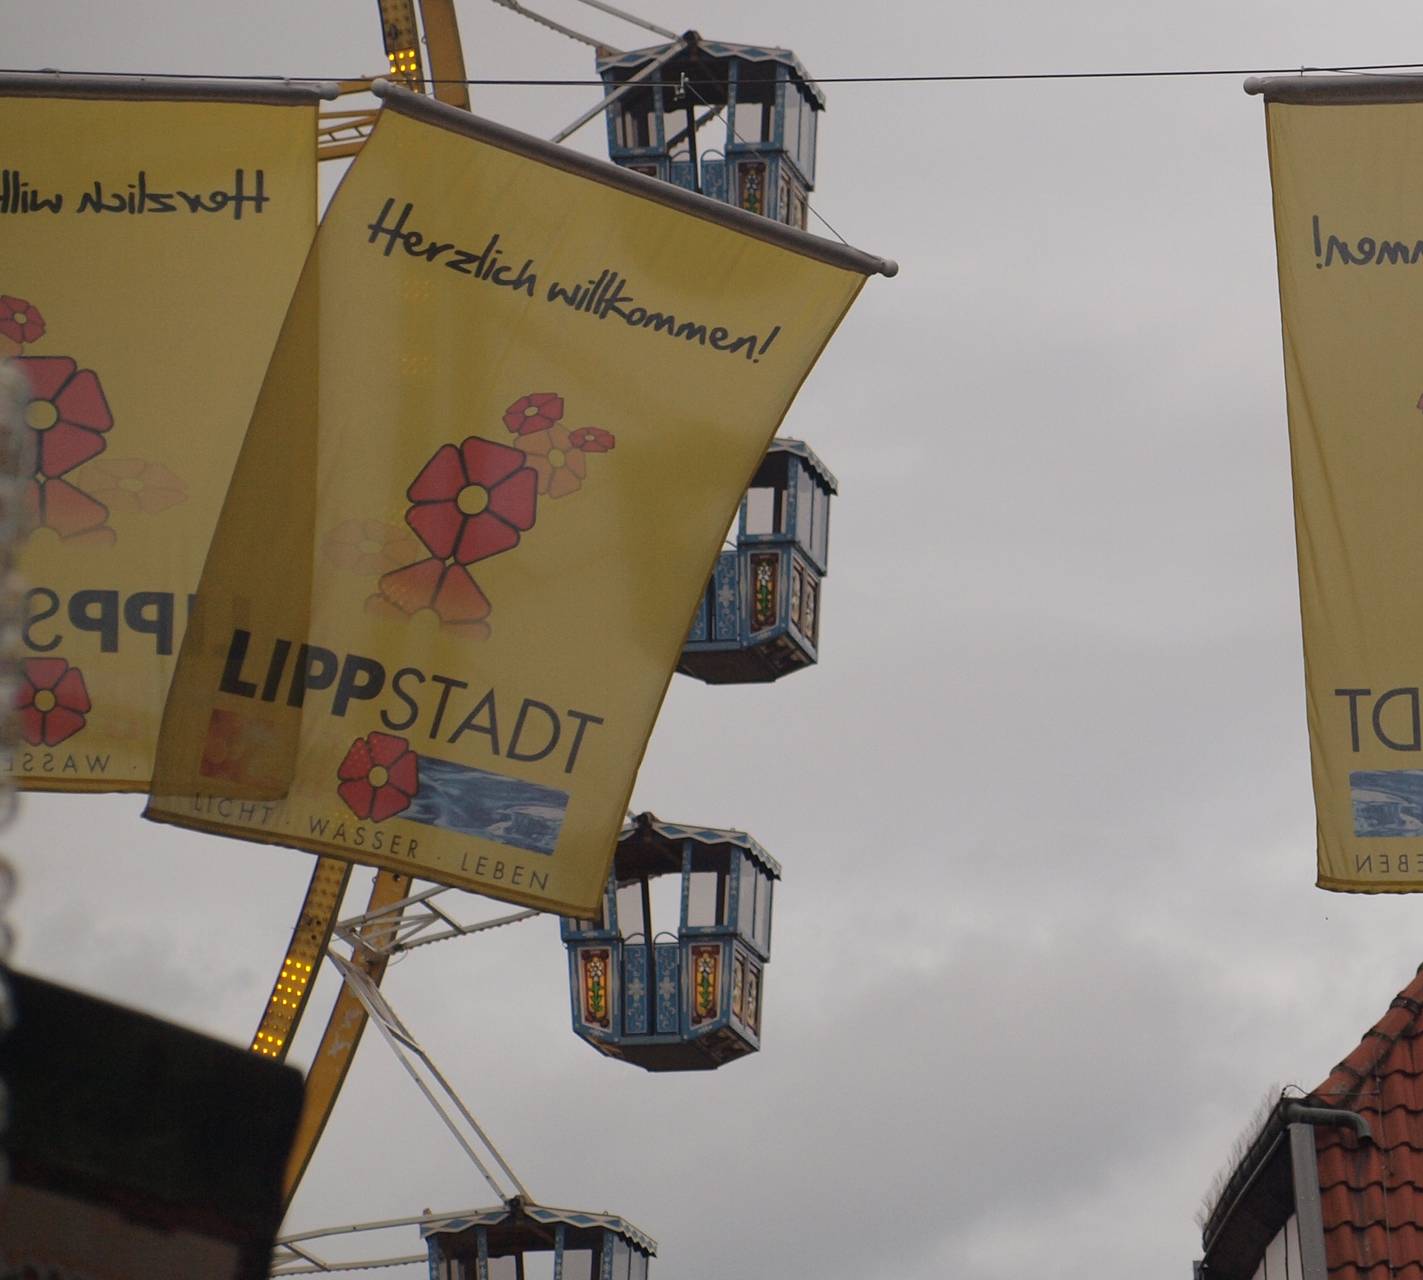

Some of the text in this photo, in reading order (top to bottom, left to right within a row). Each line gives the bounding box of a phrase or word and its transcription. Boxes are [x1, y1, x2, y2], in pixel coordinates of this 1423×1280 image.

[367, 197, 782, 364] Herzlich willkommen!
[218, 629, 604, 774] LIPPSTADT
[192, 792, 551, 891] LICHT WASSER LEBEN
